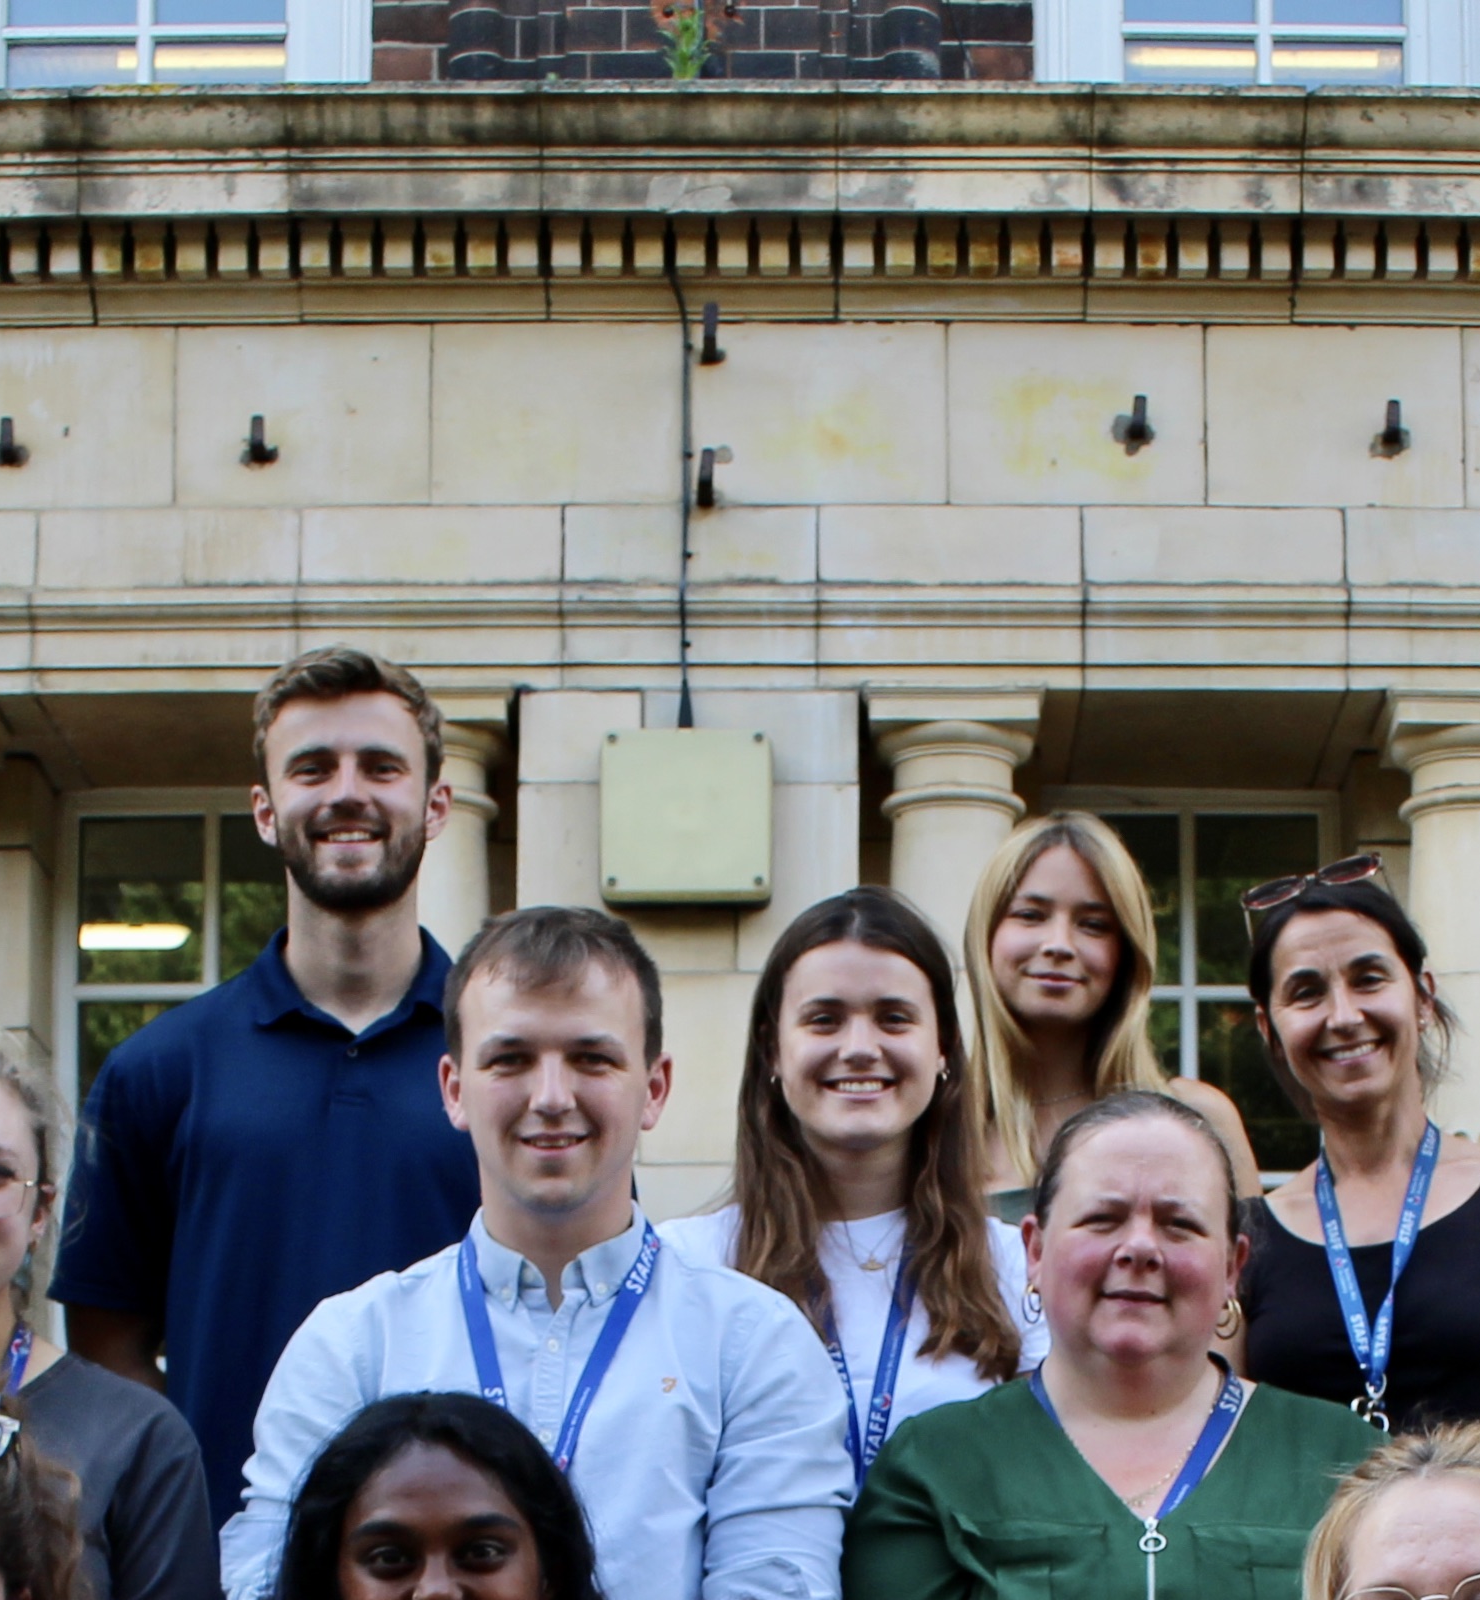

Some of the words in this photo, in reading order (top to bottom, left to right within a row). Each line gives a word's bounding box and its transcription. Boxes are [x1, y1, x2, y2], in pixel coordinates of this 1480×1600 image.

[1396, 1209, 1416, 1245] STAFF
[623, 1243, 659, 1295] STAFF
[1348, 1312, 1370, 1354] STAFF
[1371, 1315, 1392, 1358] STAFF
[1217, 1374, 1242, 1414] STA
